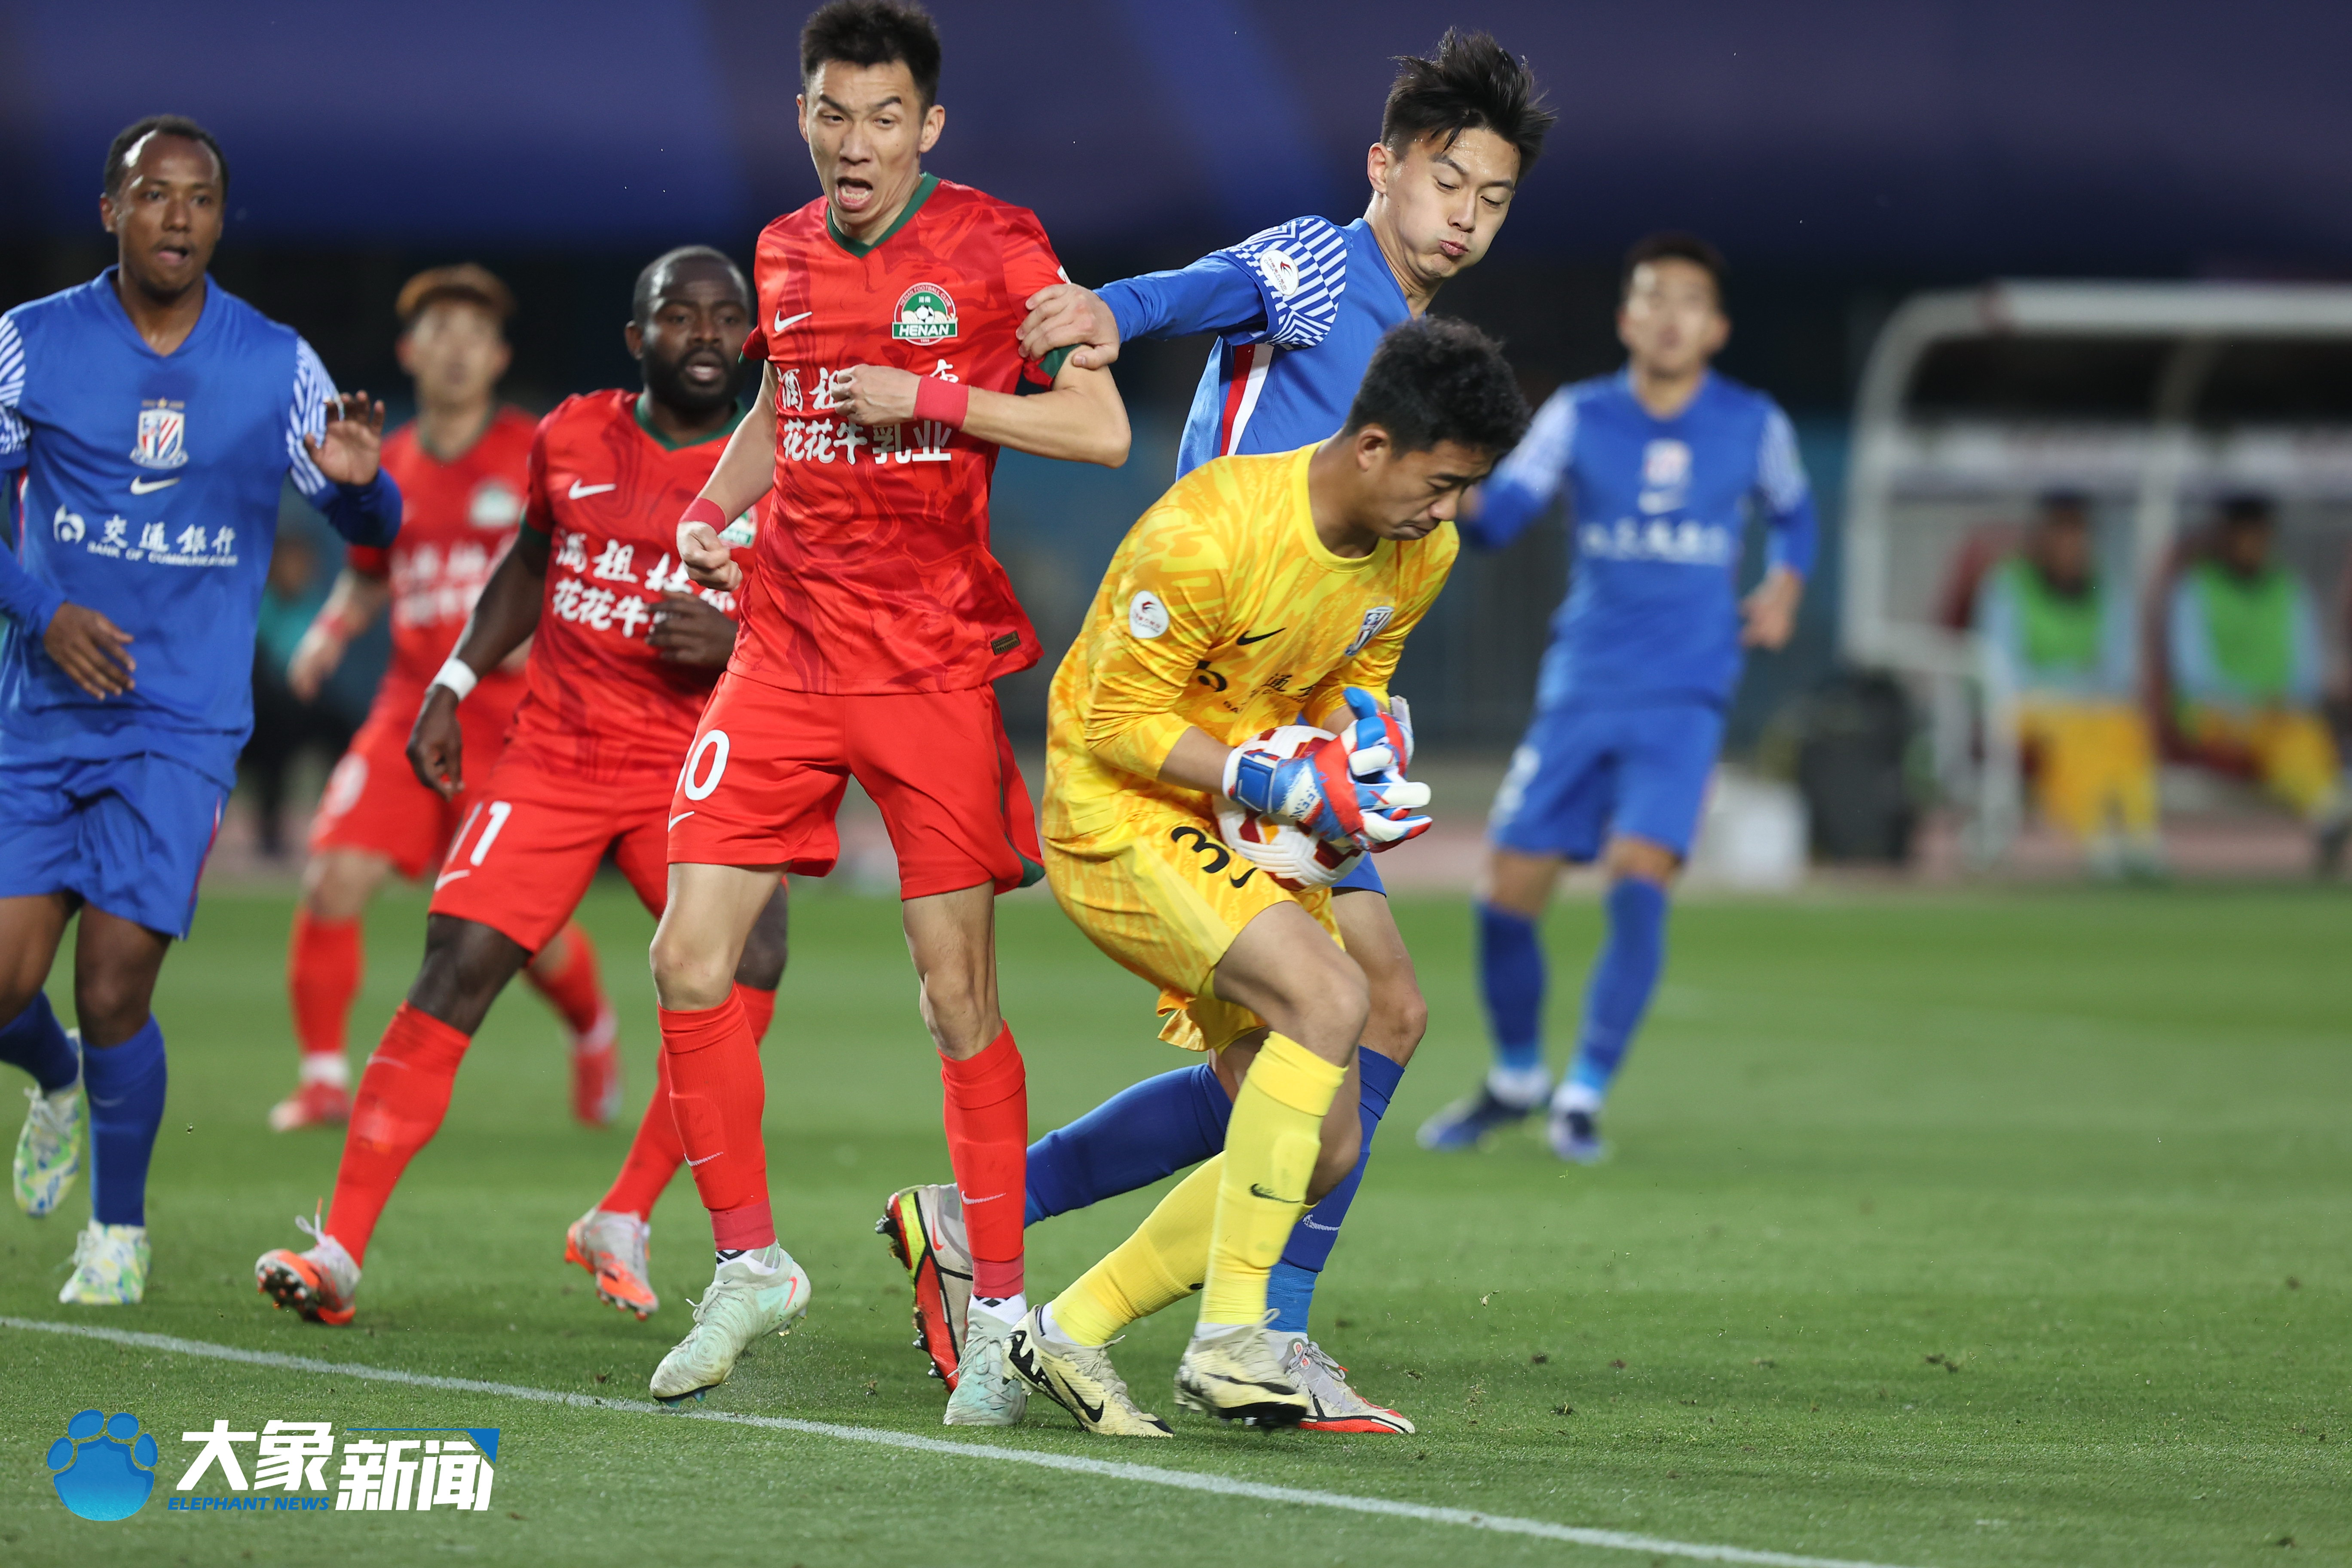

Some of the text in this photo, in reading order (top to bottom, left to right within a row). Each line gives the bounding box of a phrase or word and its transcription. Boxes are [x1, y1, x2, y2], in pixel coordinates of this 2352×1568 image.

[914, 285, 940, 295] FOOTBALL
[940, 292, 951, 307] CLUB
[899, 324, 949, 336] HENAN
[783, 417, 952, 465] 花花牛乳业
[1171, 826, 1230, 874] 3
